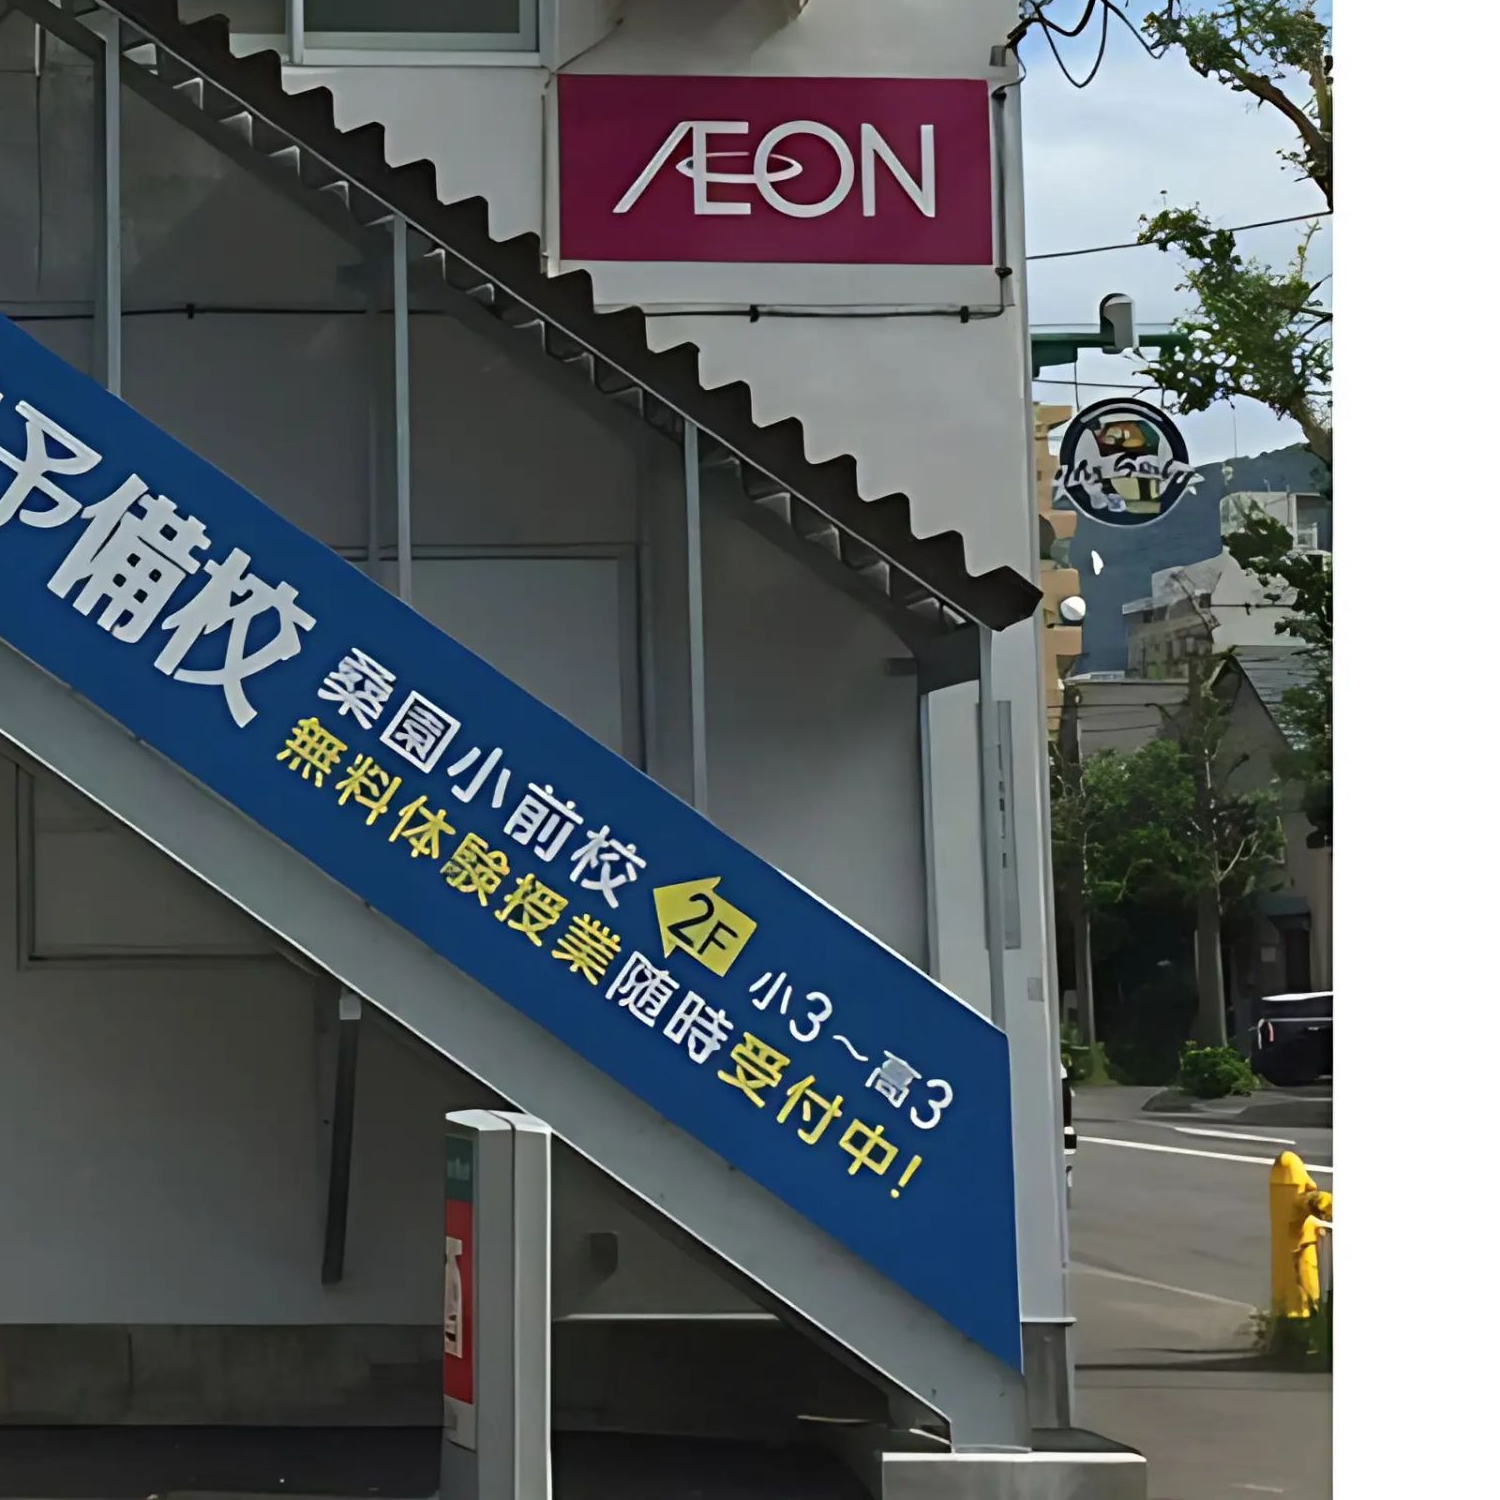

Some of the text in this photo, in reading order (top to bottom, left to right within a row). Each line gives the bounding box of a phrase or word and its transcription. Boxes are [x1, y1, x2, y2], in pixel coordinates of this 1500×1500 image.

[612, 120, 936, 218] AEON
[316, 647, 647, 909] 桑園小前校
[667, 892, 740, 959] 2F
